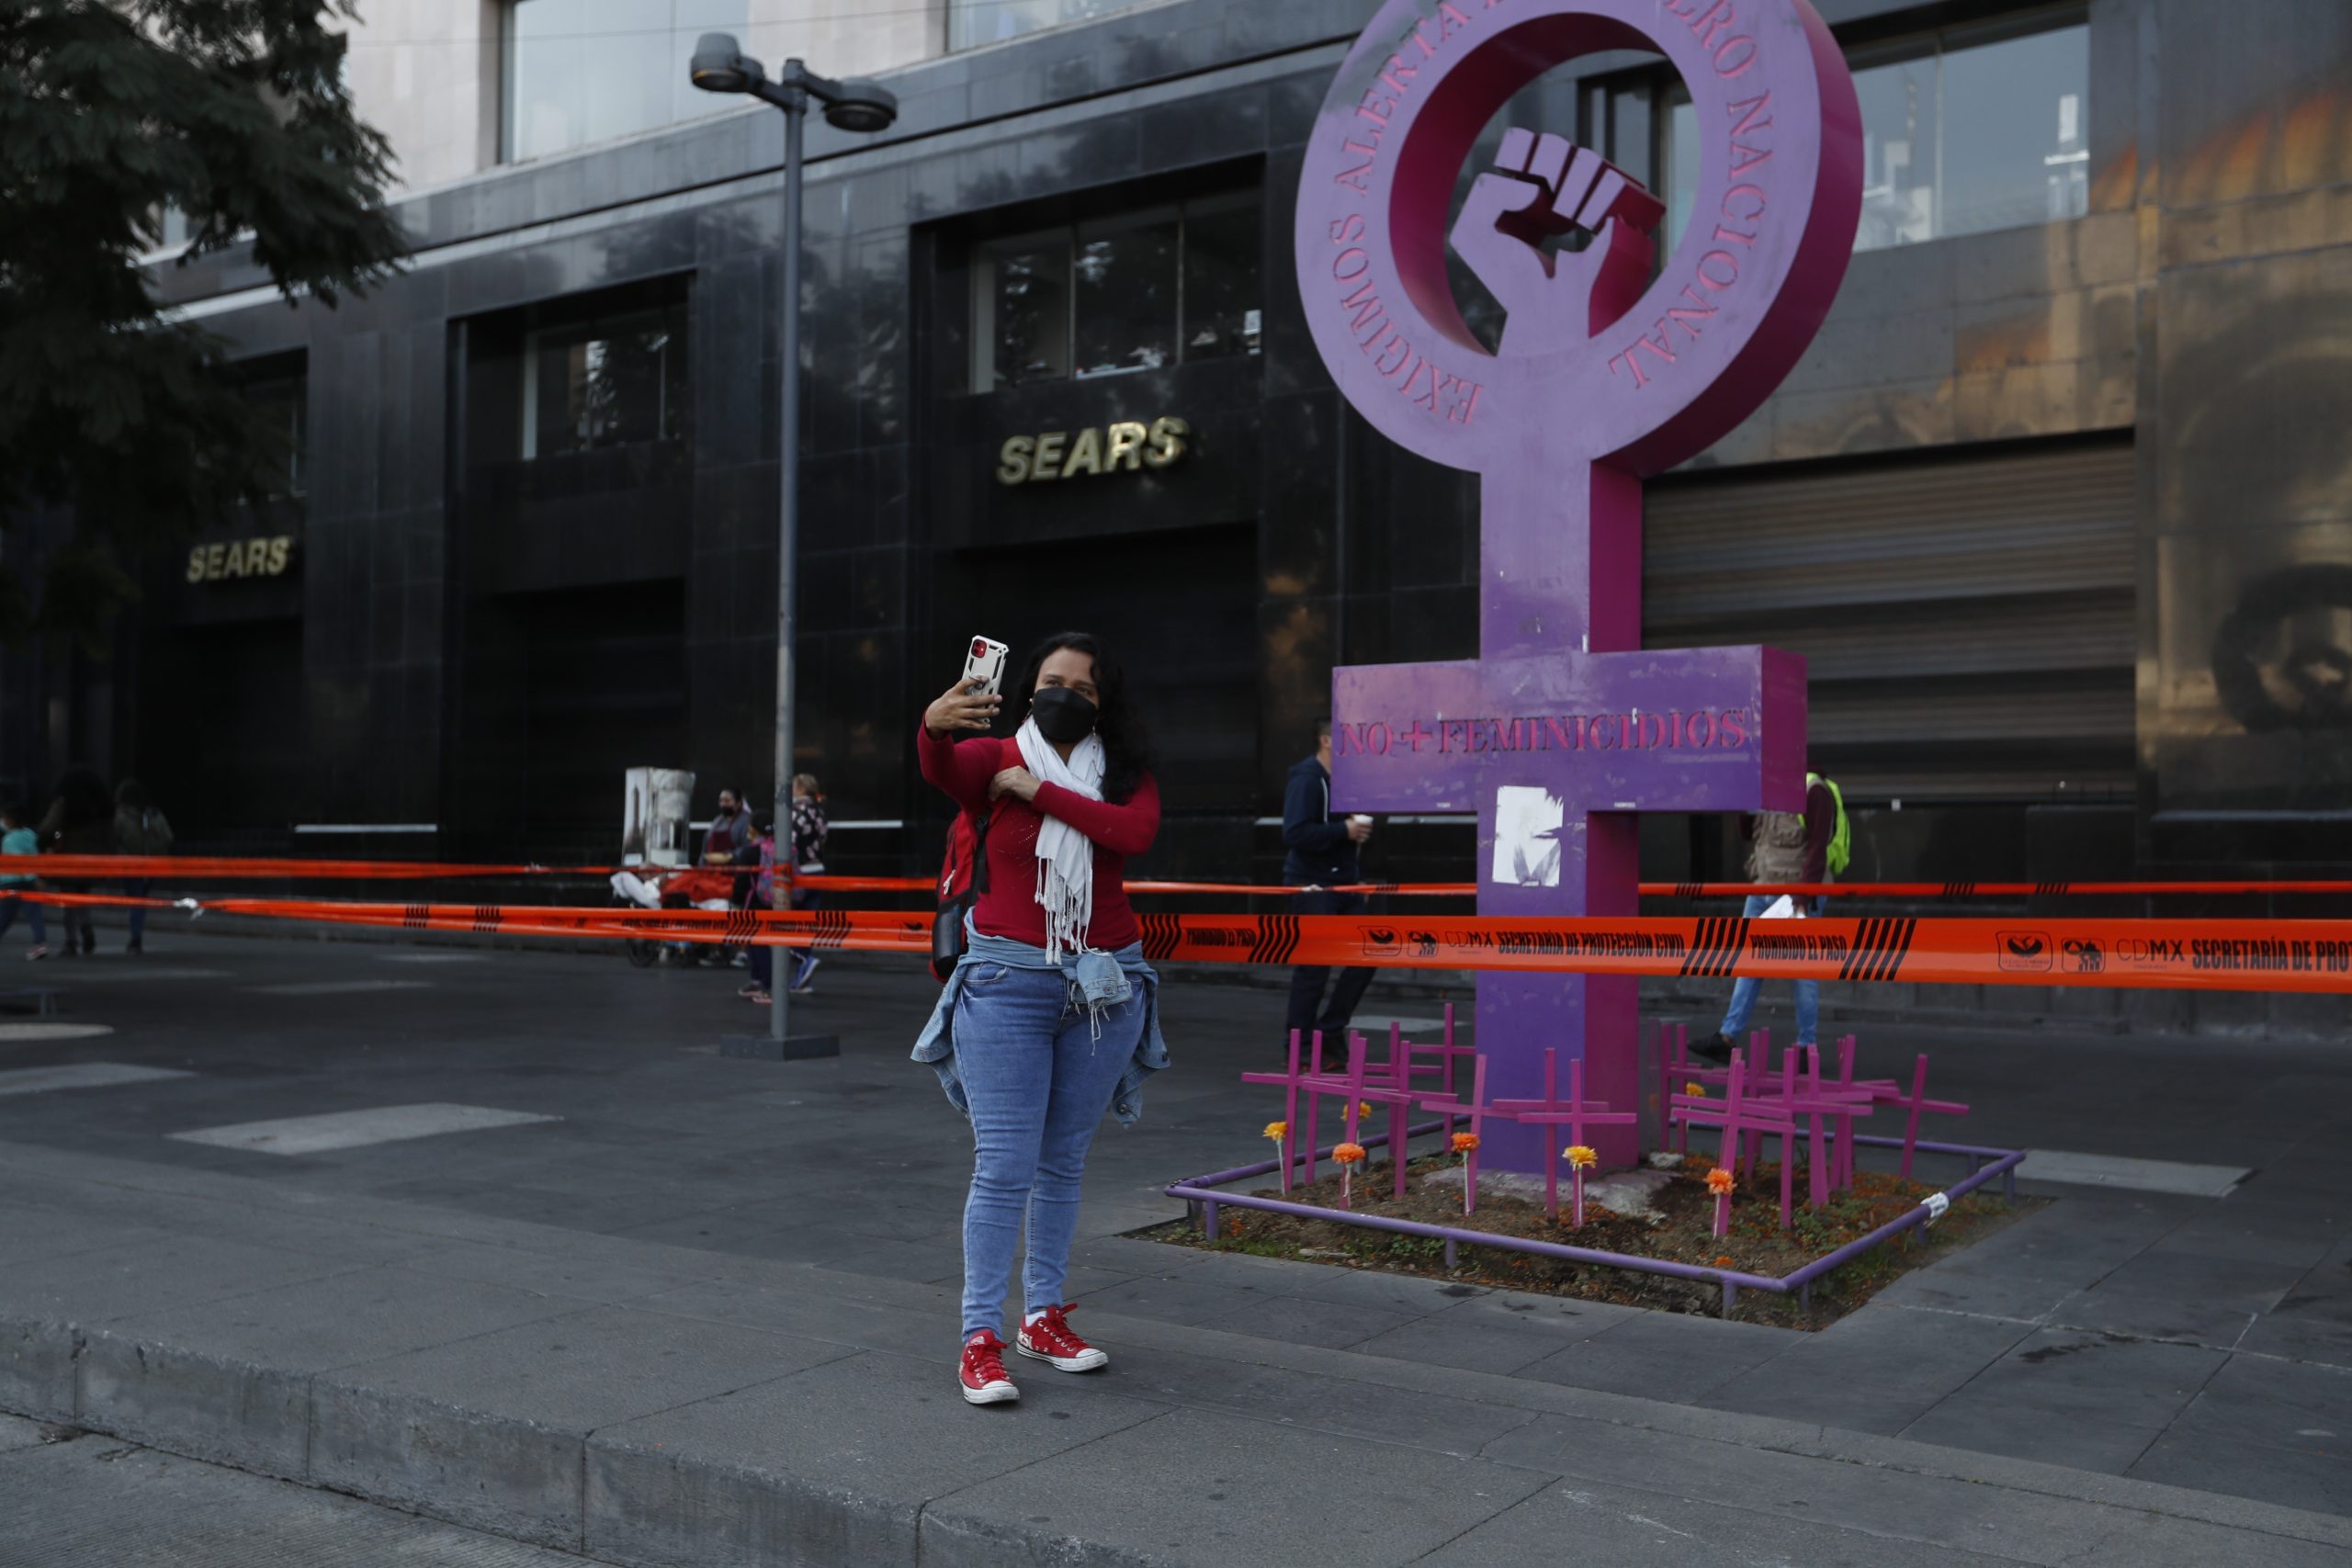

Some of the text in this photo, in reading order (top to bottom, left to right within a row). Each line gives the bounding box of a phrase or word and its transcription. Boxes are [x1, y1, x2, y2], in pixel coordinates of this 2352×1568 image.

[1335, 0, 1472, 197] ALERTA
[1608, 89, 1774, 390] NACIONAL
[1329, 213, 1484, 426] EXIGIMOS
[996, 415, 1191, 486] SEARS
[187, 535, 291, 583] SEARS
[1444, 931, 1494, 949] CDMX
[1564, 931, 1579, 956] DE
[1749, 933, 1847, 962] PROHIBIDO EL PASO
[2116, 935, 2352, 973] CDMX SECRETARÍA DE PRO
